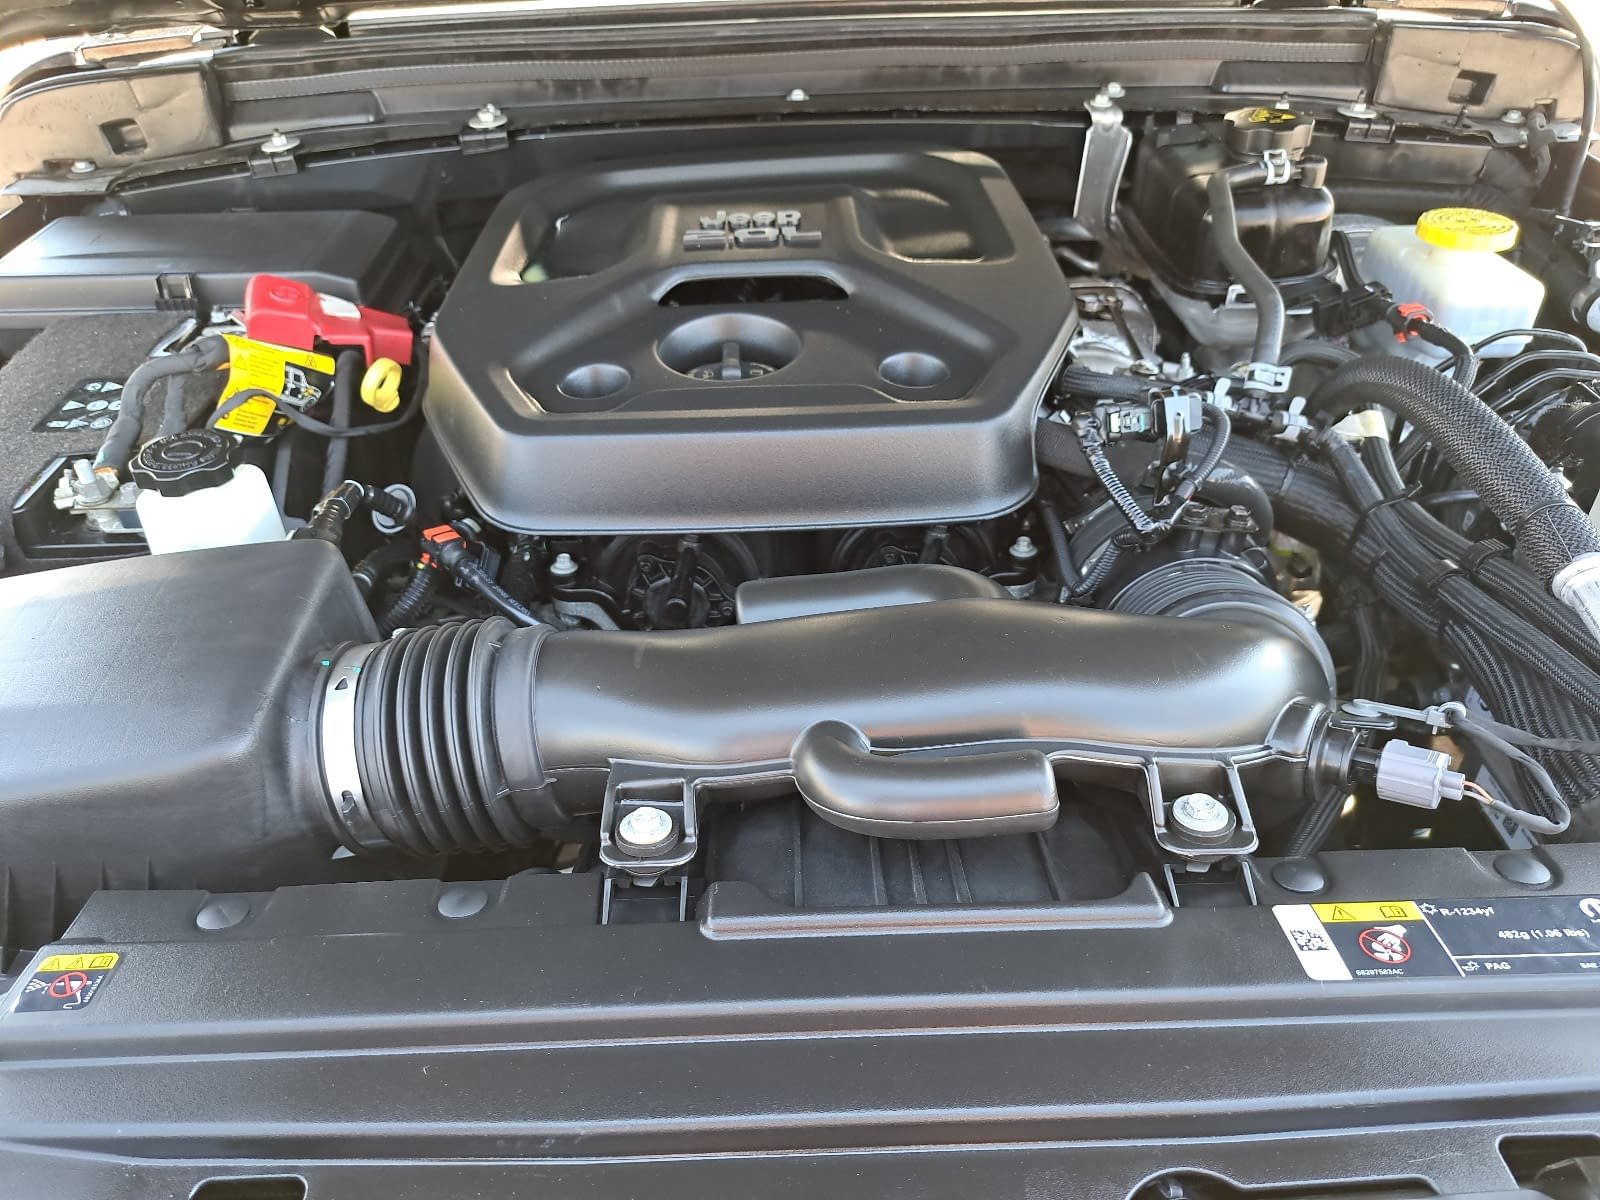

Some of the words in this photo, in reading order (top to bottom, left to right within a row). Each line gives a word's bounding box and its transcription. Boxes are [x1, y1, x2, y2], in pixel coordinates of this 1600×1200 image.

[699, 210, 802, 230] Jeep
[682, 227, 823, 251] 2.0L
[1439, 906, 1495, 917] R-1234yf
[1562, 928, 1591, 939] lbs)
[1484, 961, 1512, 970] PAG
